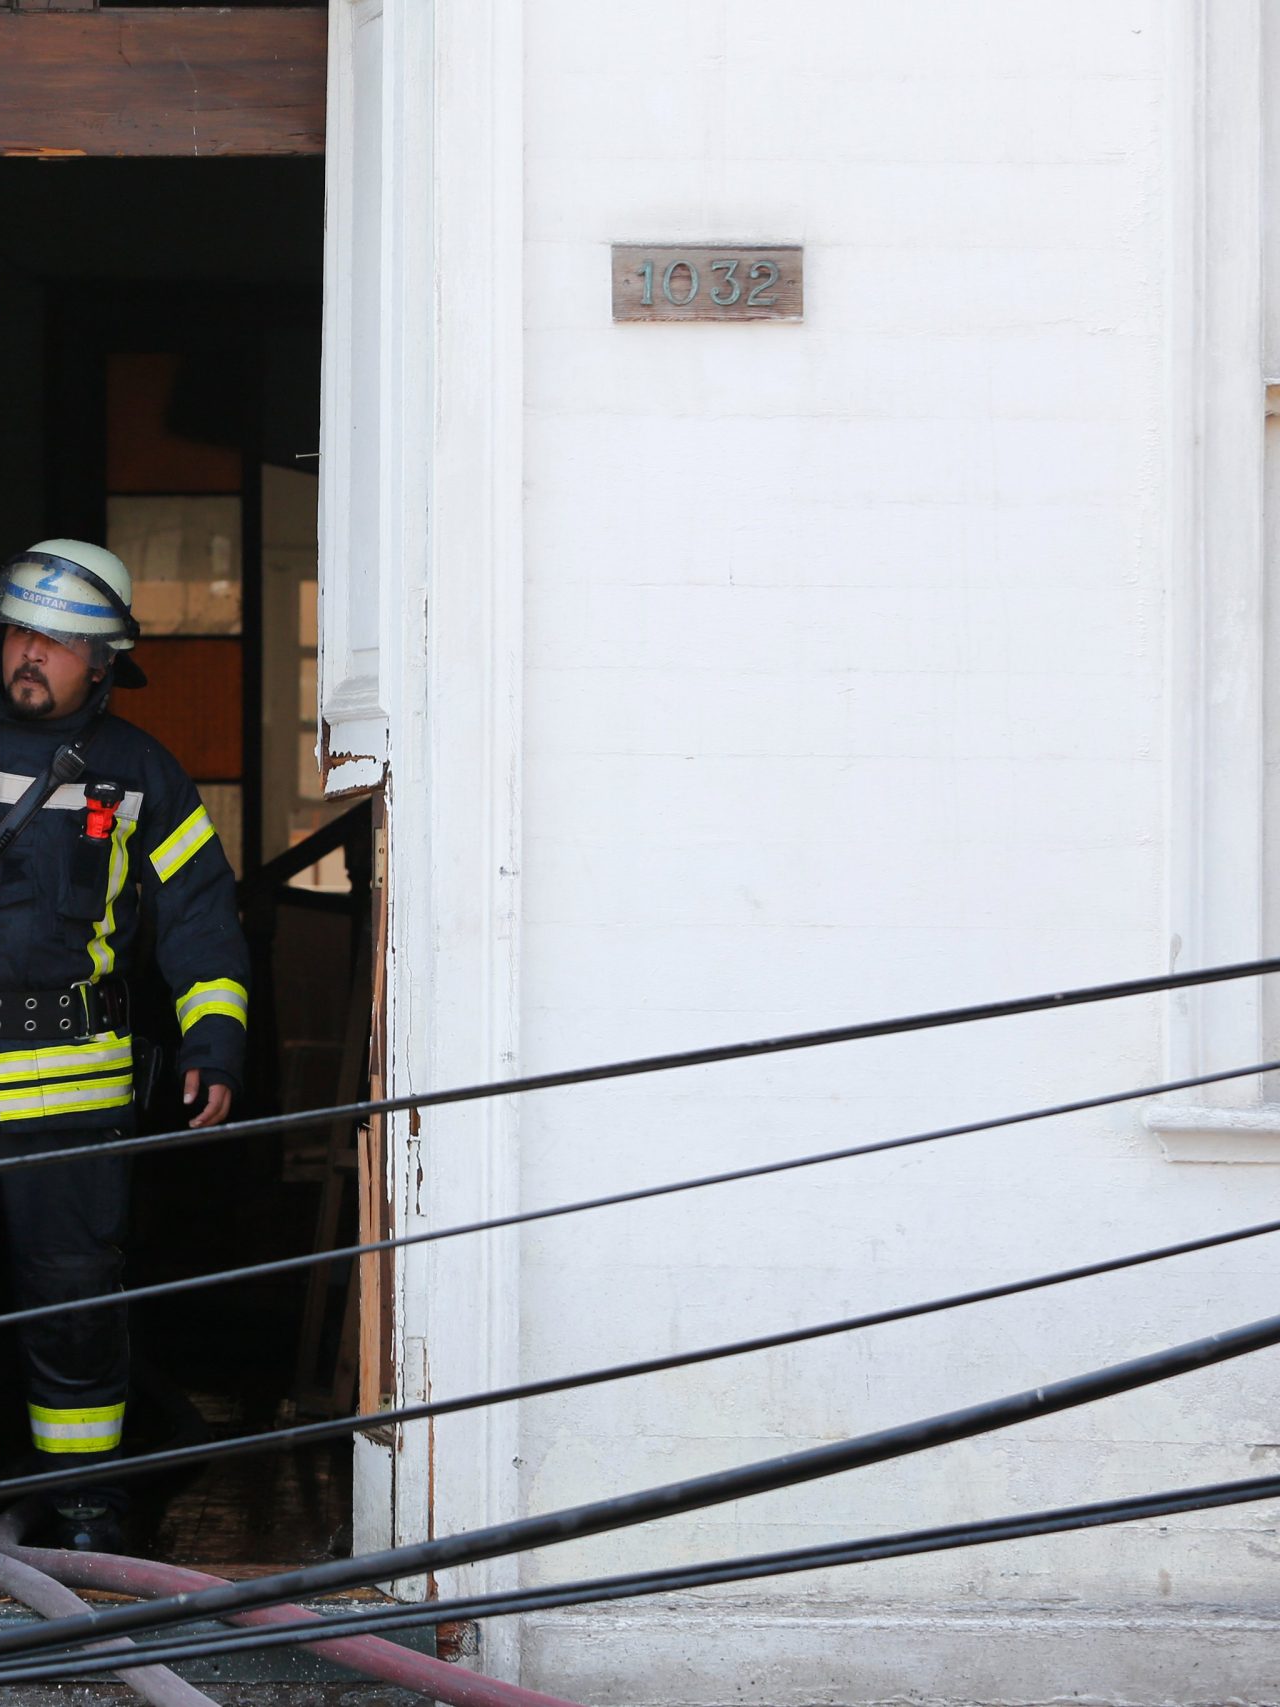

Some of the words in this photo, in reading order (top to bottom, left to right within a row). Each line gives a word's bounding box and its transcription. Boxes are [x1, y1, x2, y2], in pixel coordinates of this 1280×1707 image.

[636, 259, 780, 306] 1032
[35, 562, 65, 594] 2
[22, 591, 68, 610] CAPITAN
